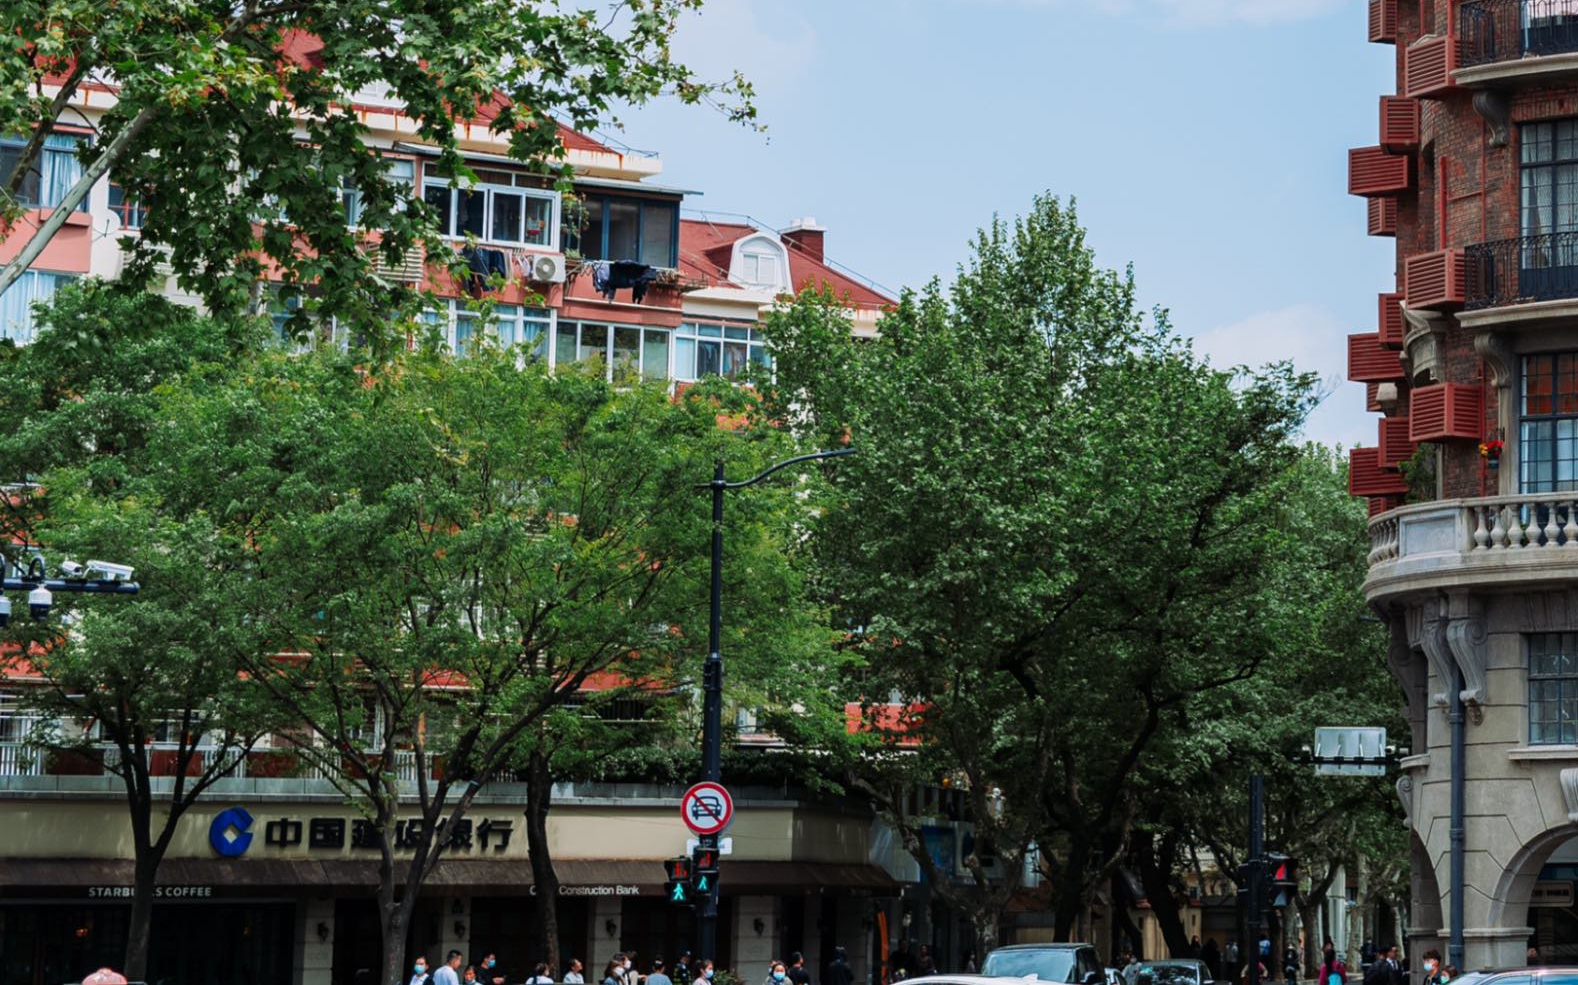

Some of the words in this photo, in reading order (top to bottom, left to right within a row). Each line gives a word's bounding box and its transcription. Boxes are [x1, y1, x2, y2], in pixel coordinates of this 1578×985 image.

[165, 887, 212, 897] COFFEE
[559, 886, 614, 896] Construction
[616, 886, 640, 896] Bank
